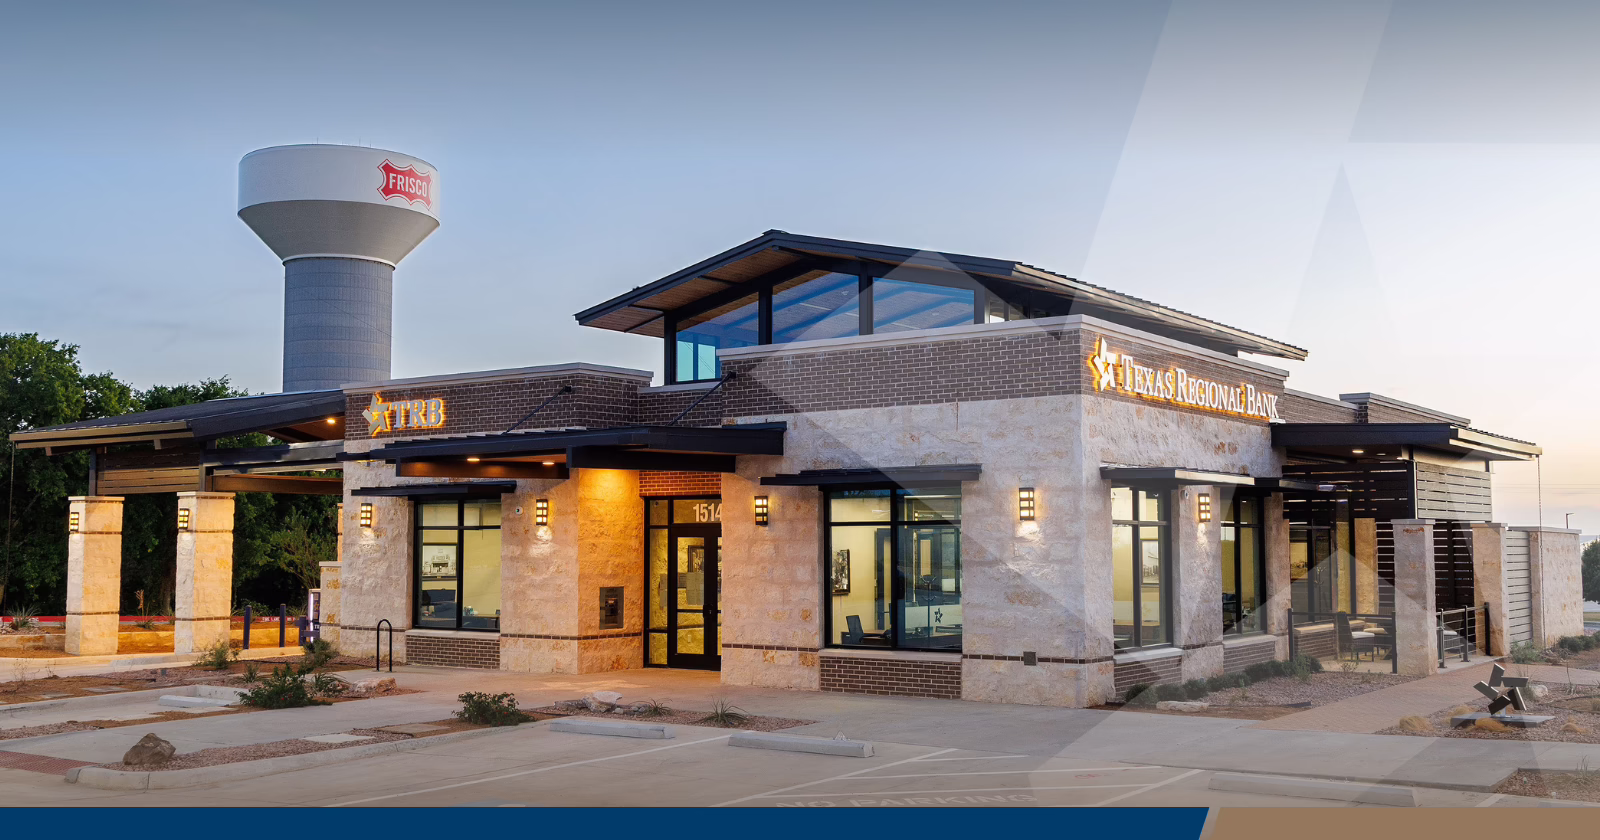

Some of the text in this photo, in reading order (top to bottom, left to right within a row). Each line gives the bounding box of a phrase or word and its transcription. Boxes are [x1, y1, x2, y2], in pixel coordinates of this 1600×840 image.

[389, 173, 428, 197] FRISCO
[391, 399, 442, 428] TRB
[849, 794, 1038, 807] PARKING
